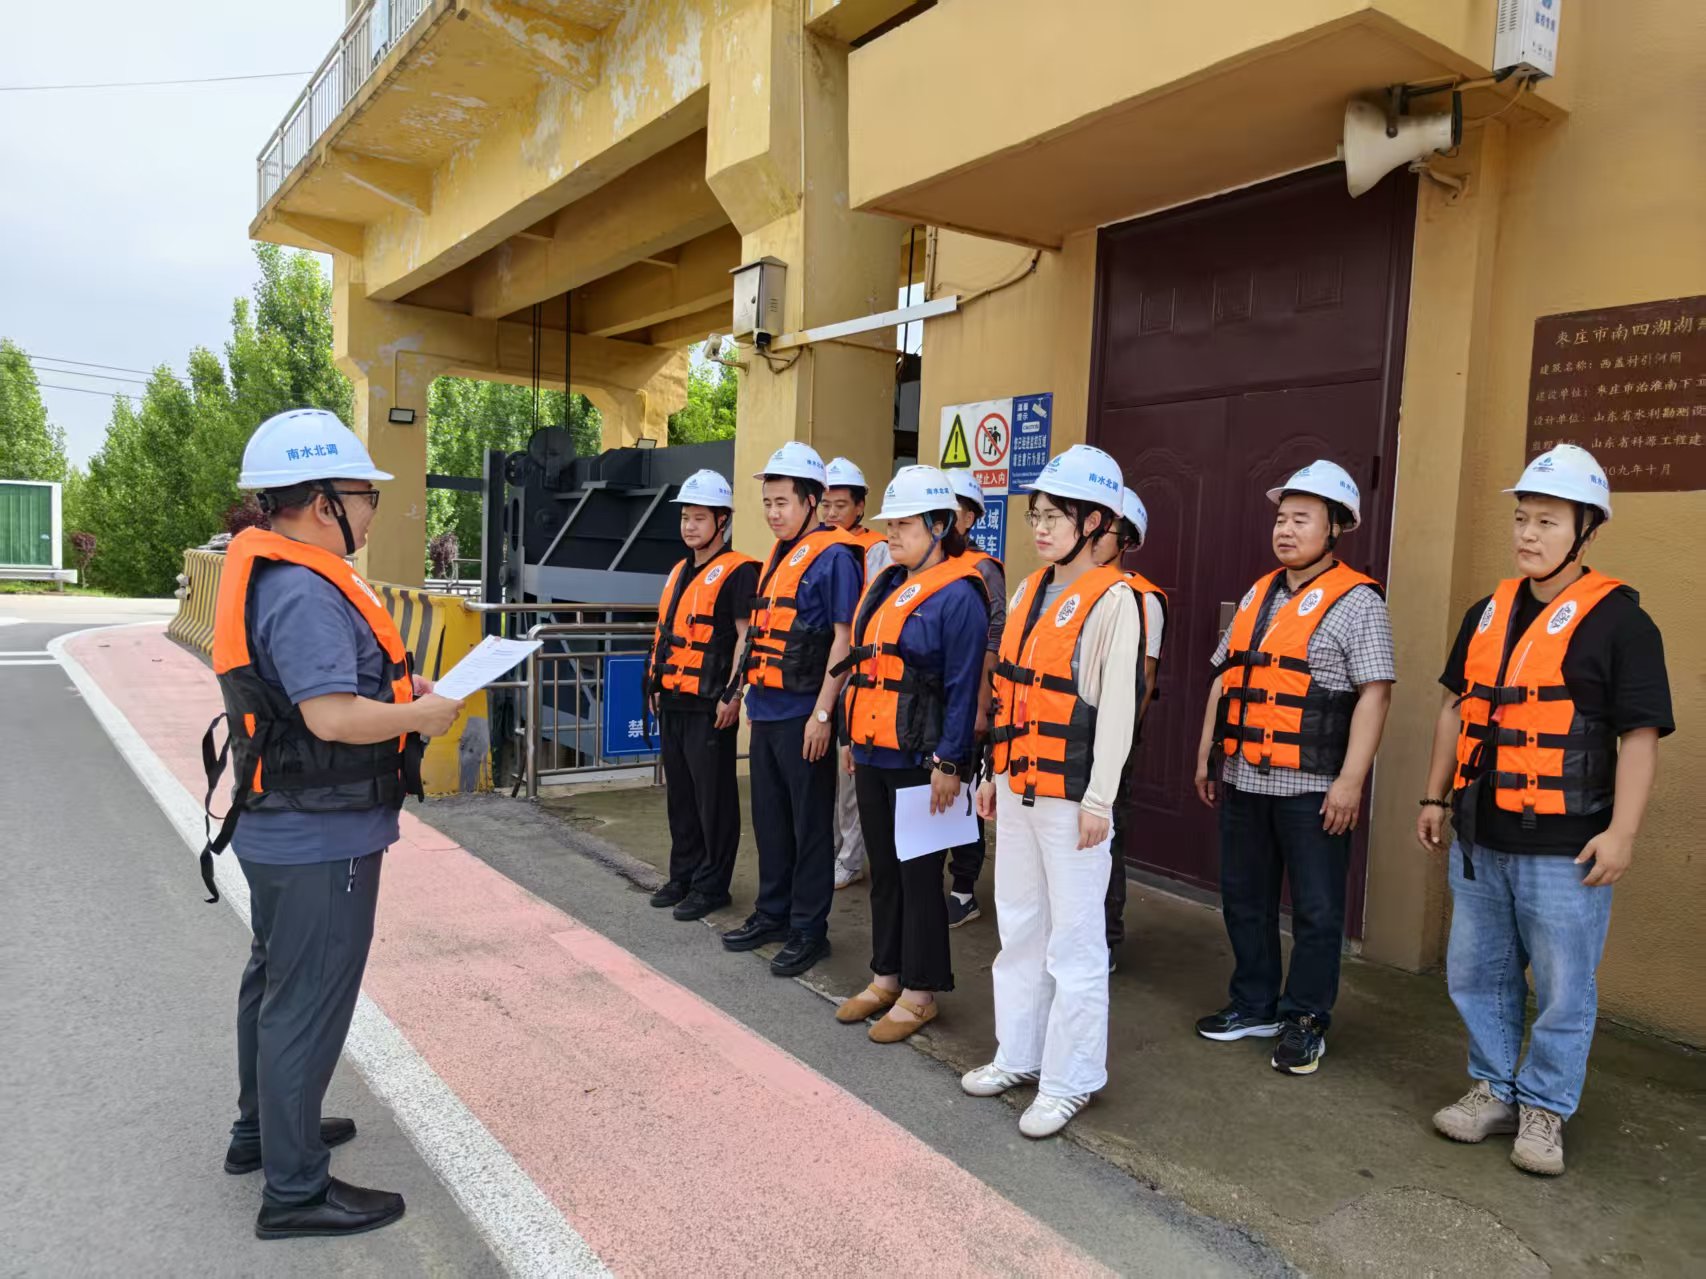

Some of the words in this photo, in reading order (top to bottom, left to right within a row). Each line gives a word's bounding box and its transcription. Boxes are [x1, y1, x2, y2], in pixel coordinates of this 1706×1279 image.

[286, 444, 338, 461] 南水北调
[1089, 473, 1119, 492] 南水北调
[971, 508, 999, 530] 区域
[970, 534, 997, 556] 停车
